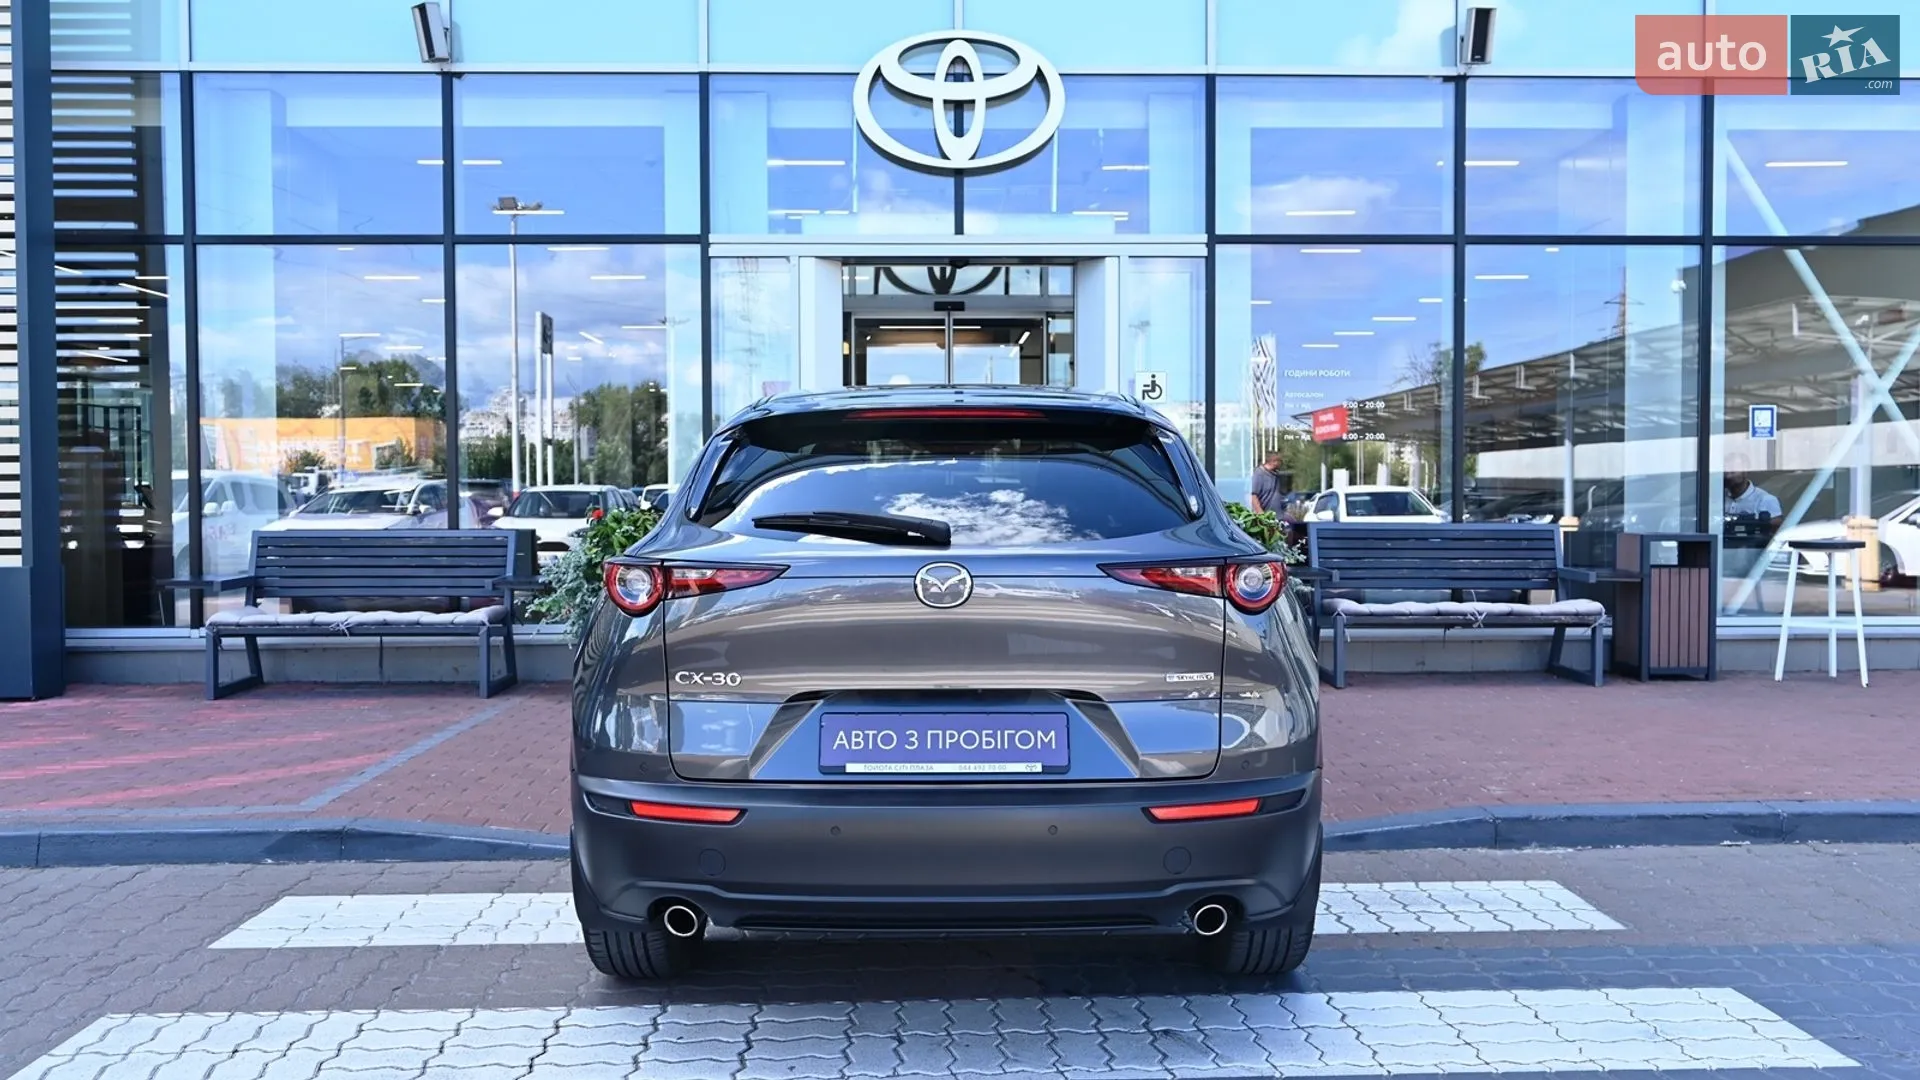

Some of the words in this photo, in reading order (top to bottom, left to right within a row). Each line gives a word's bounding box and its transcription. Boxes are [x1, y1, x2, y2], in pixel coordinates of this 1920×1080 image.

[1284, 369, 1317, 378] ГОДИНИ
[1318, 369, 1351, 377] РОБОТИ
[674, 671, 742, 687] CX-30
[832, 730, 898, 750] АВТО
[926, 730, 1057, 750] ПРОБІГОМ
